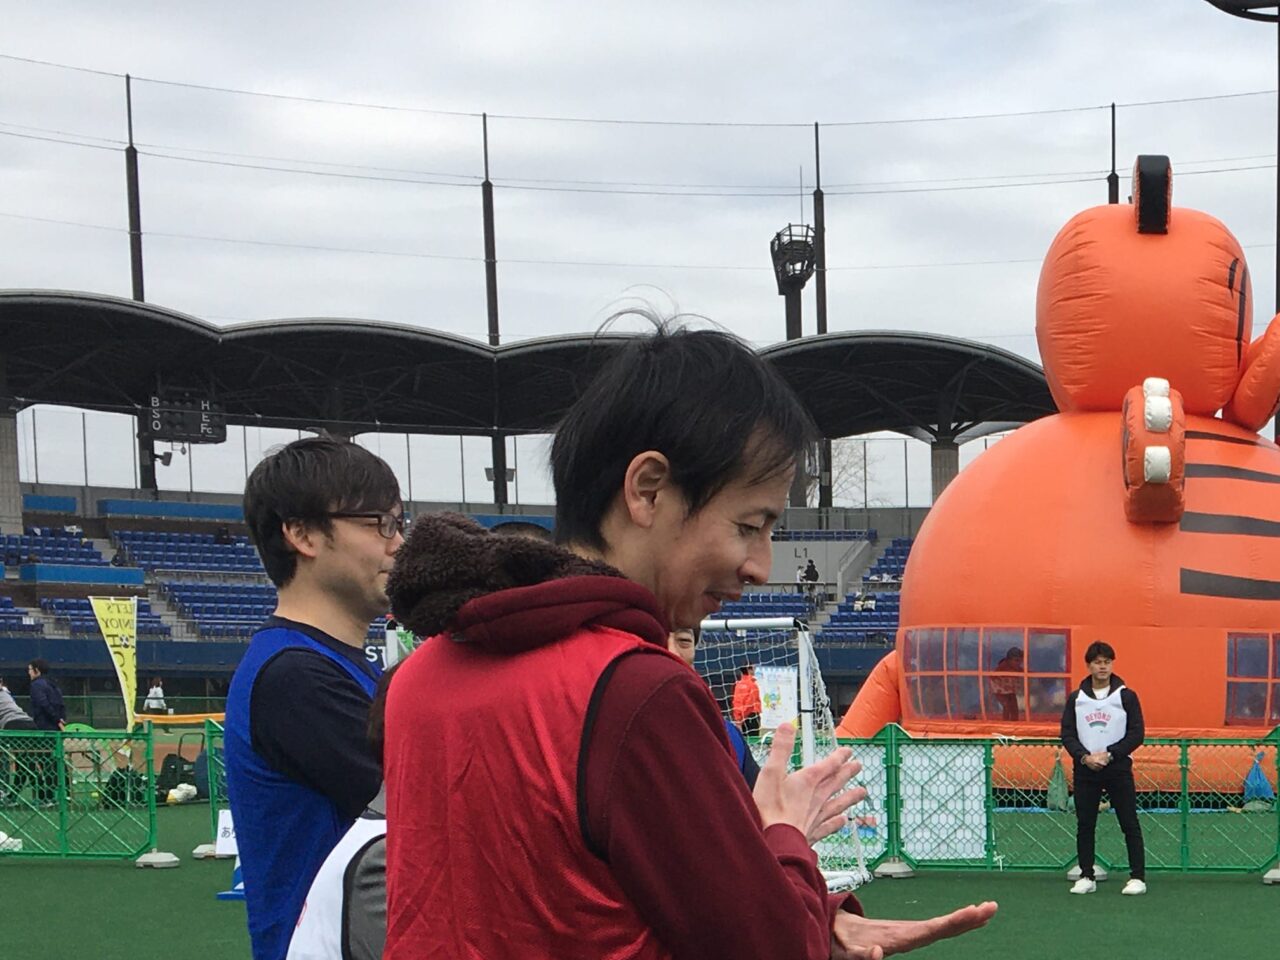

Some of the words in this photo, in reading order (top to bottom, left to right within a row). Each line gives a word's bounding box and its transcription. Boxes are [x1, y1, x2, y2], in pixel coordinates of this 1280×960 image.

[151, 396, 160, 407] B
[201, 400, 210, 411] H
[152, 409, 161, 419] S
[202, 412, 211, 422] E
[794, 547, 808, 558] L1
